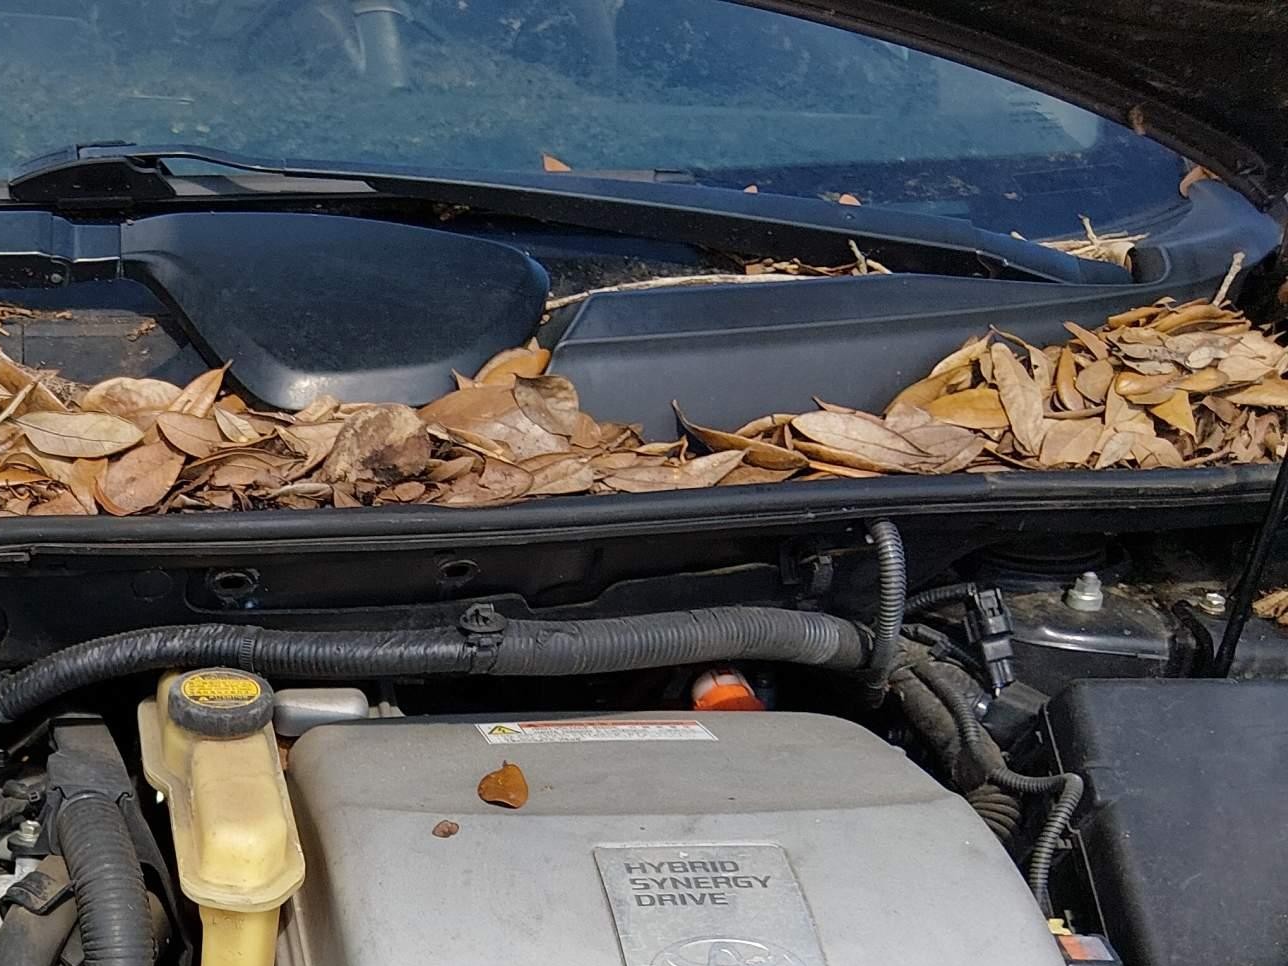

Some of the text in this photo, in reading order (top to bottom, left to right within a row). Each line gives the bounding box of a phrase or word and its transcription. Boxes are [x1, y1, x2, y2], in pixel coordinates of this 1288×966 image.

[623, 860, 740, 875] HYBRID
[629, 875, 772, 891] SYNERGY
[634, 891, 730, 907] DRIVE
